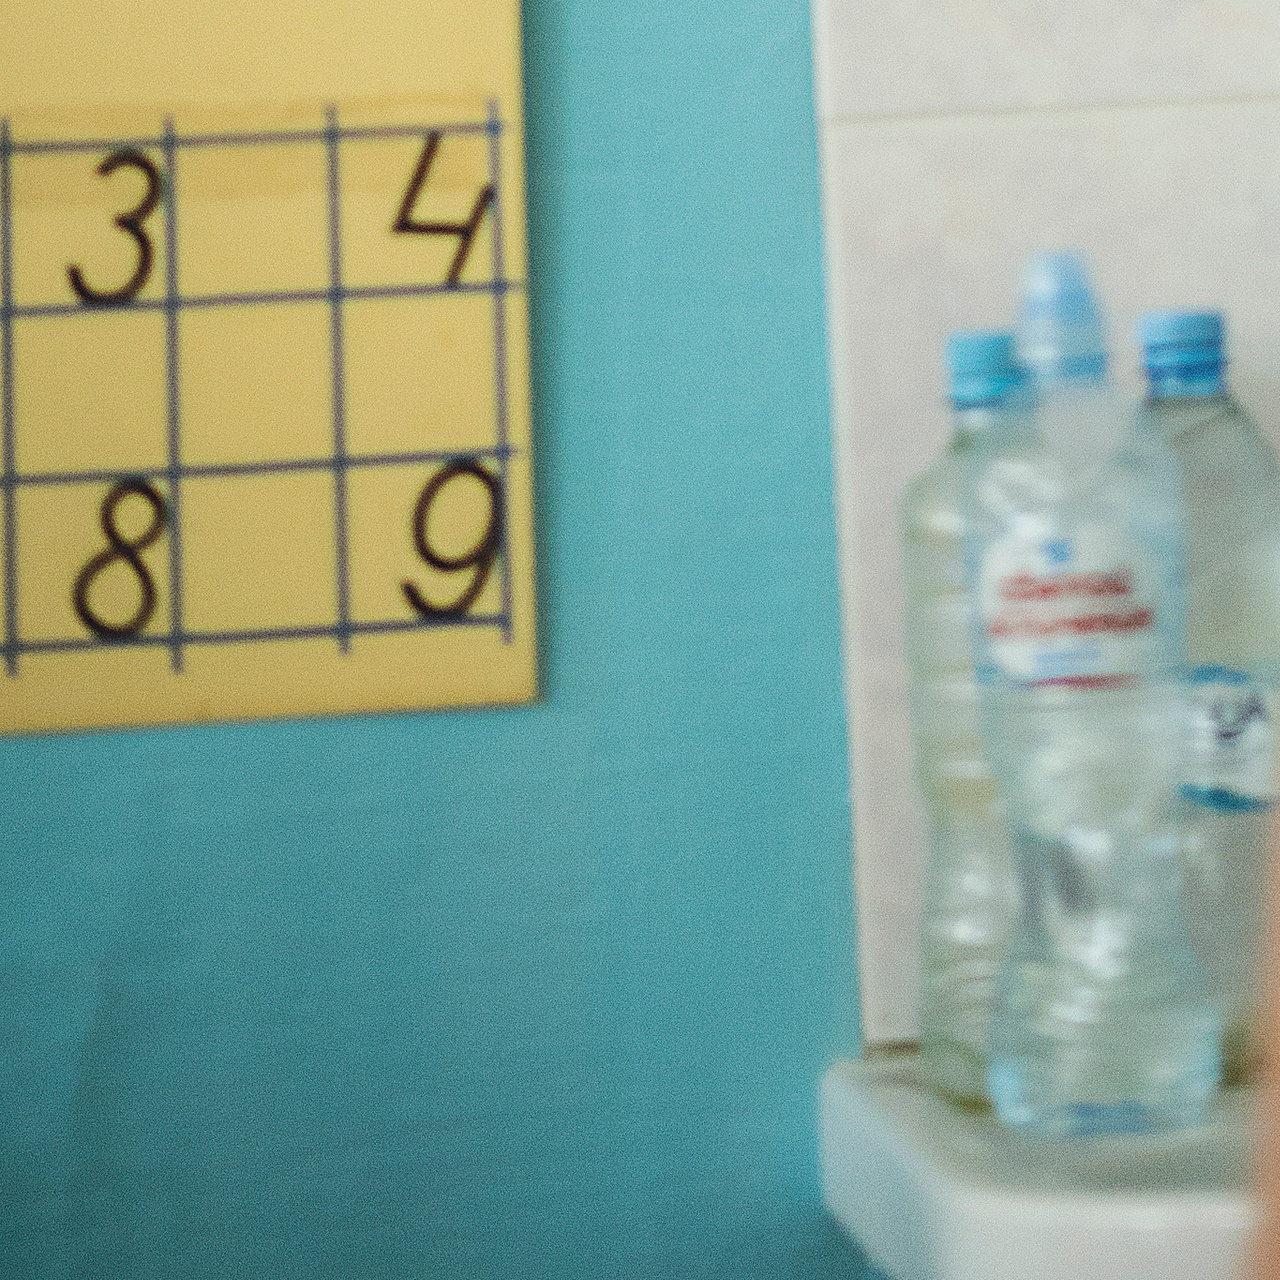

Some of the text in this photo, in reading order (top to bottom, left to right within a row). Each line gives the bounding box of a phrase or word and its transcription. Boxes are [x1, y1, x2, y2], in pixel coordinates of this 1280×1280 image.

[65, 148, 165, 309] 3
[391, 130, 496, 289] 4
[72, 475, 167, 642] 8
[401, 457, 501, 620] 9
